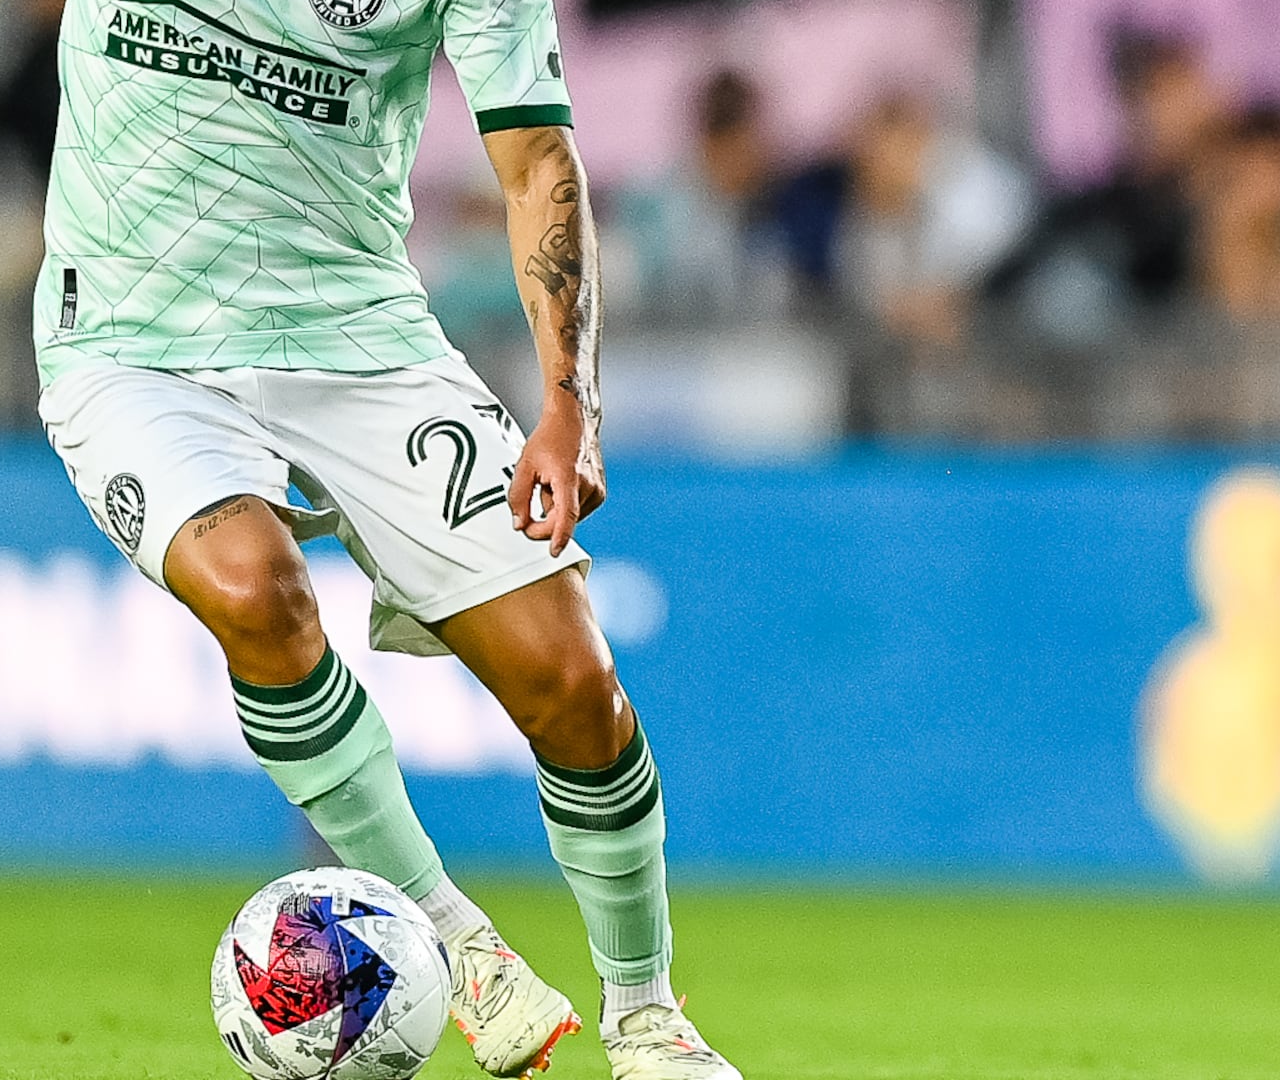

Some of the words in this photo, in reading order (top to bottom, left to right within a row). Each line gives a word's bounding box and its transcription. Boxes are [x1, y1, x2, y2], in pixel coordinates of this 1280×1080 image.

[108, 9, 242, 69] AMERICAN
[254, 53, 357, 98] FAMILY
[355, 10, 371, 24] FC
[406, 403, 517, 531] 2
